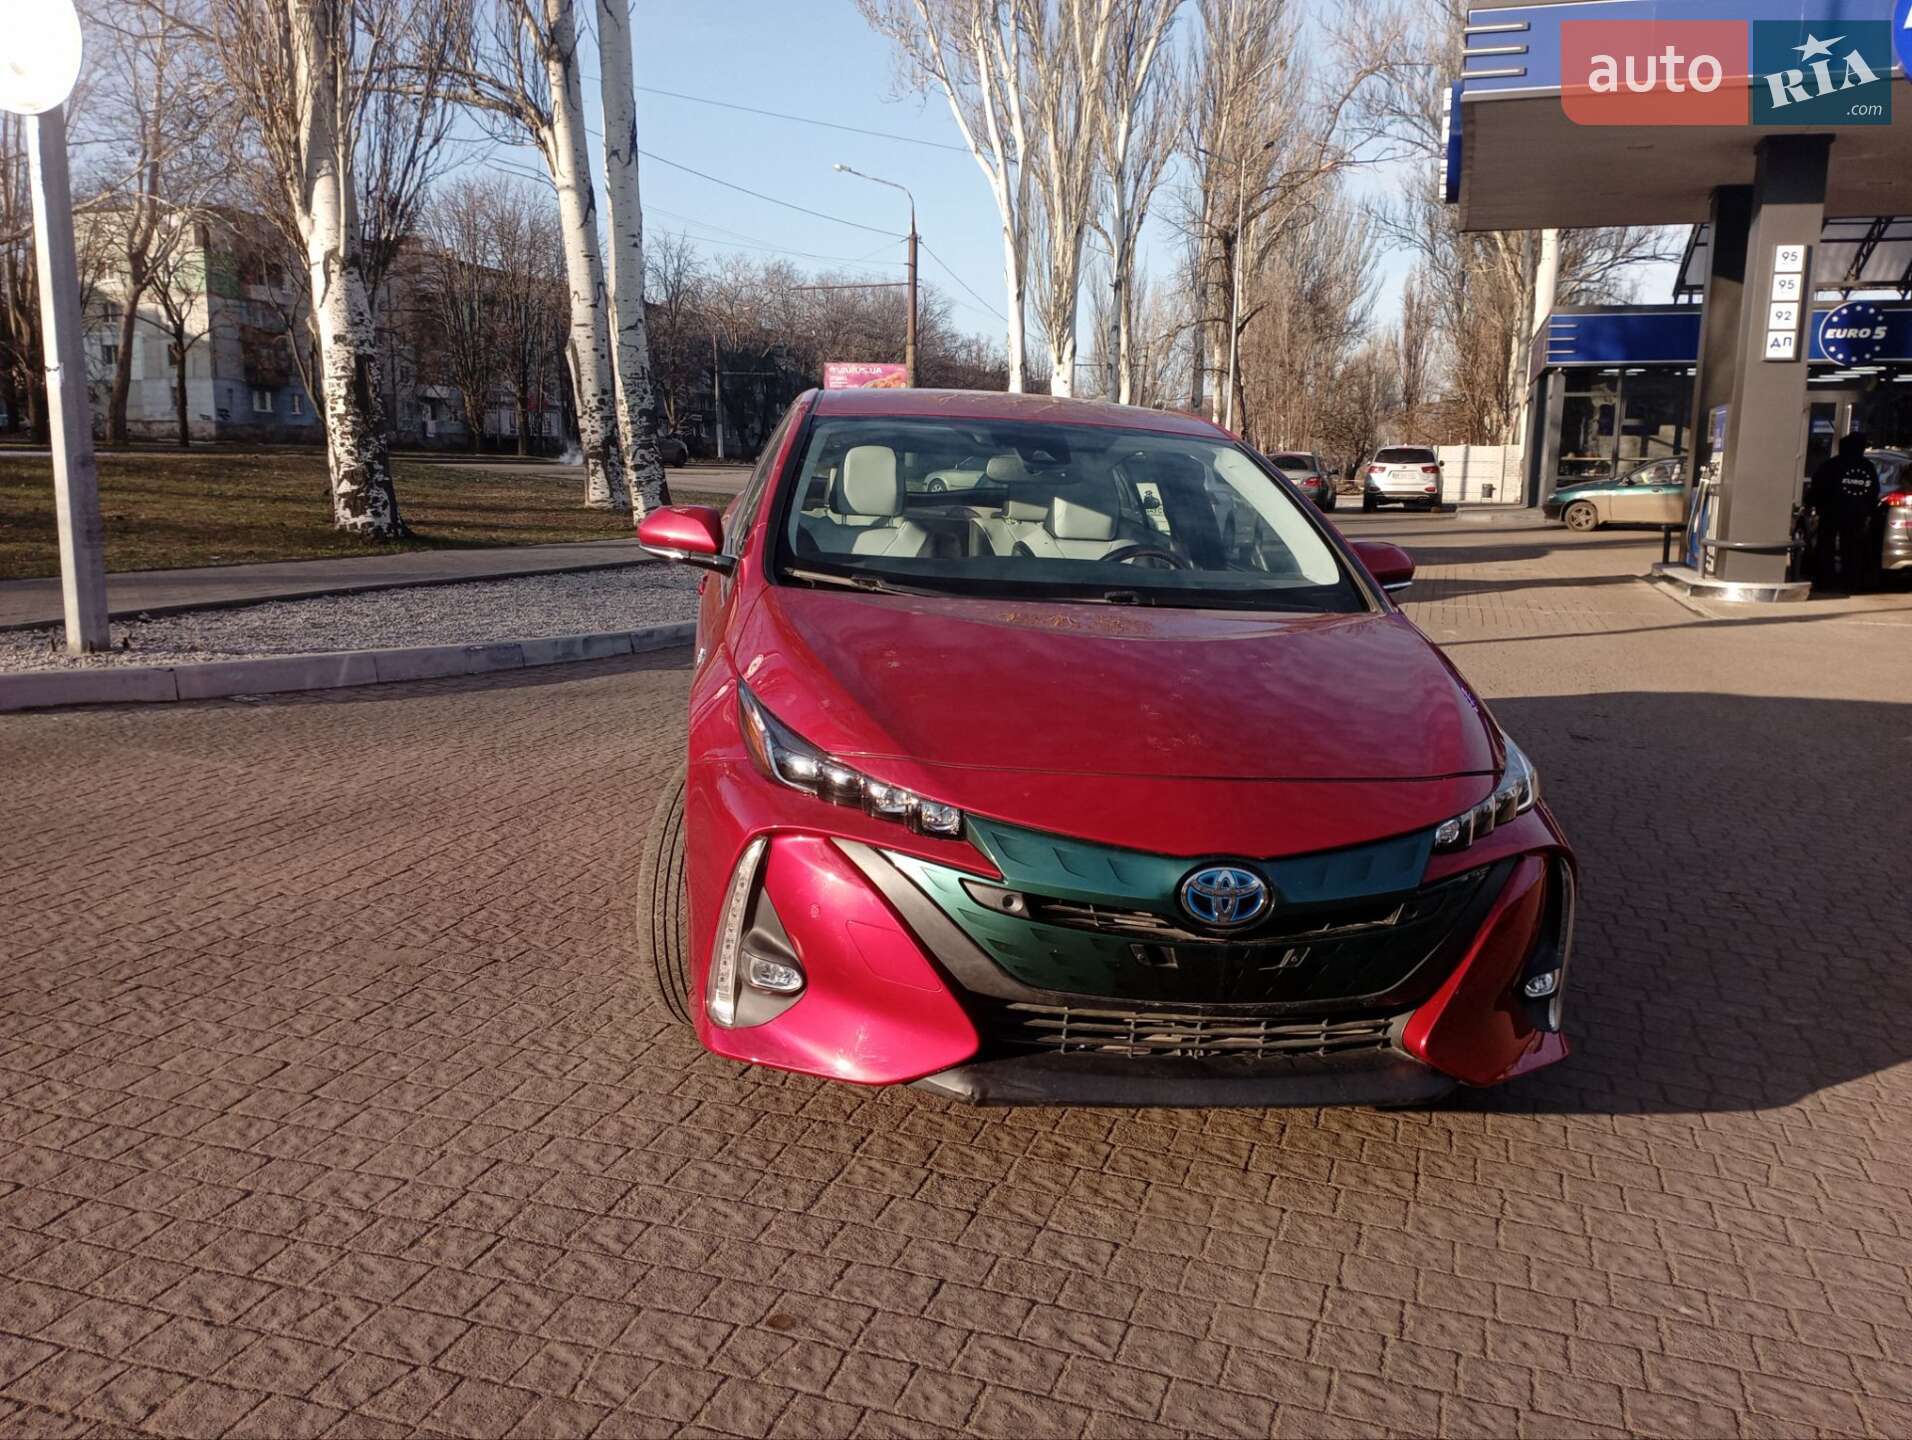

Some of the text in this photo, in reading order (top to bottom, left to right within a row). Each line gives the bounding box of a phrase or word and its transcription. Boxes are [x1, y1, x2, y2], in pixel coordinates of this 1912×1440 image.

[1781, 251, 1798, 262] 95
[1778, 280, 1795, 290] 95
[1775, 311, 1792, 321] 92
[1825, 326, 1888, 340] EURO 5
[1770, 336, 1792, 348] ДП
